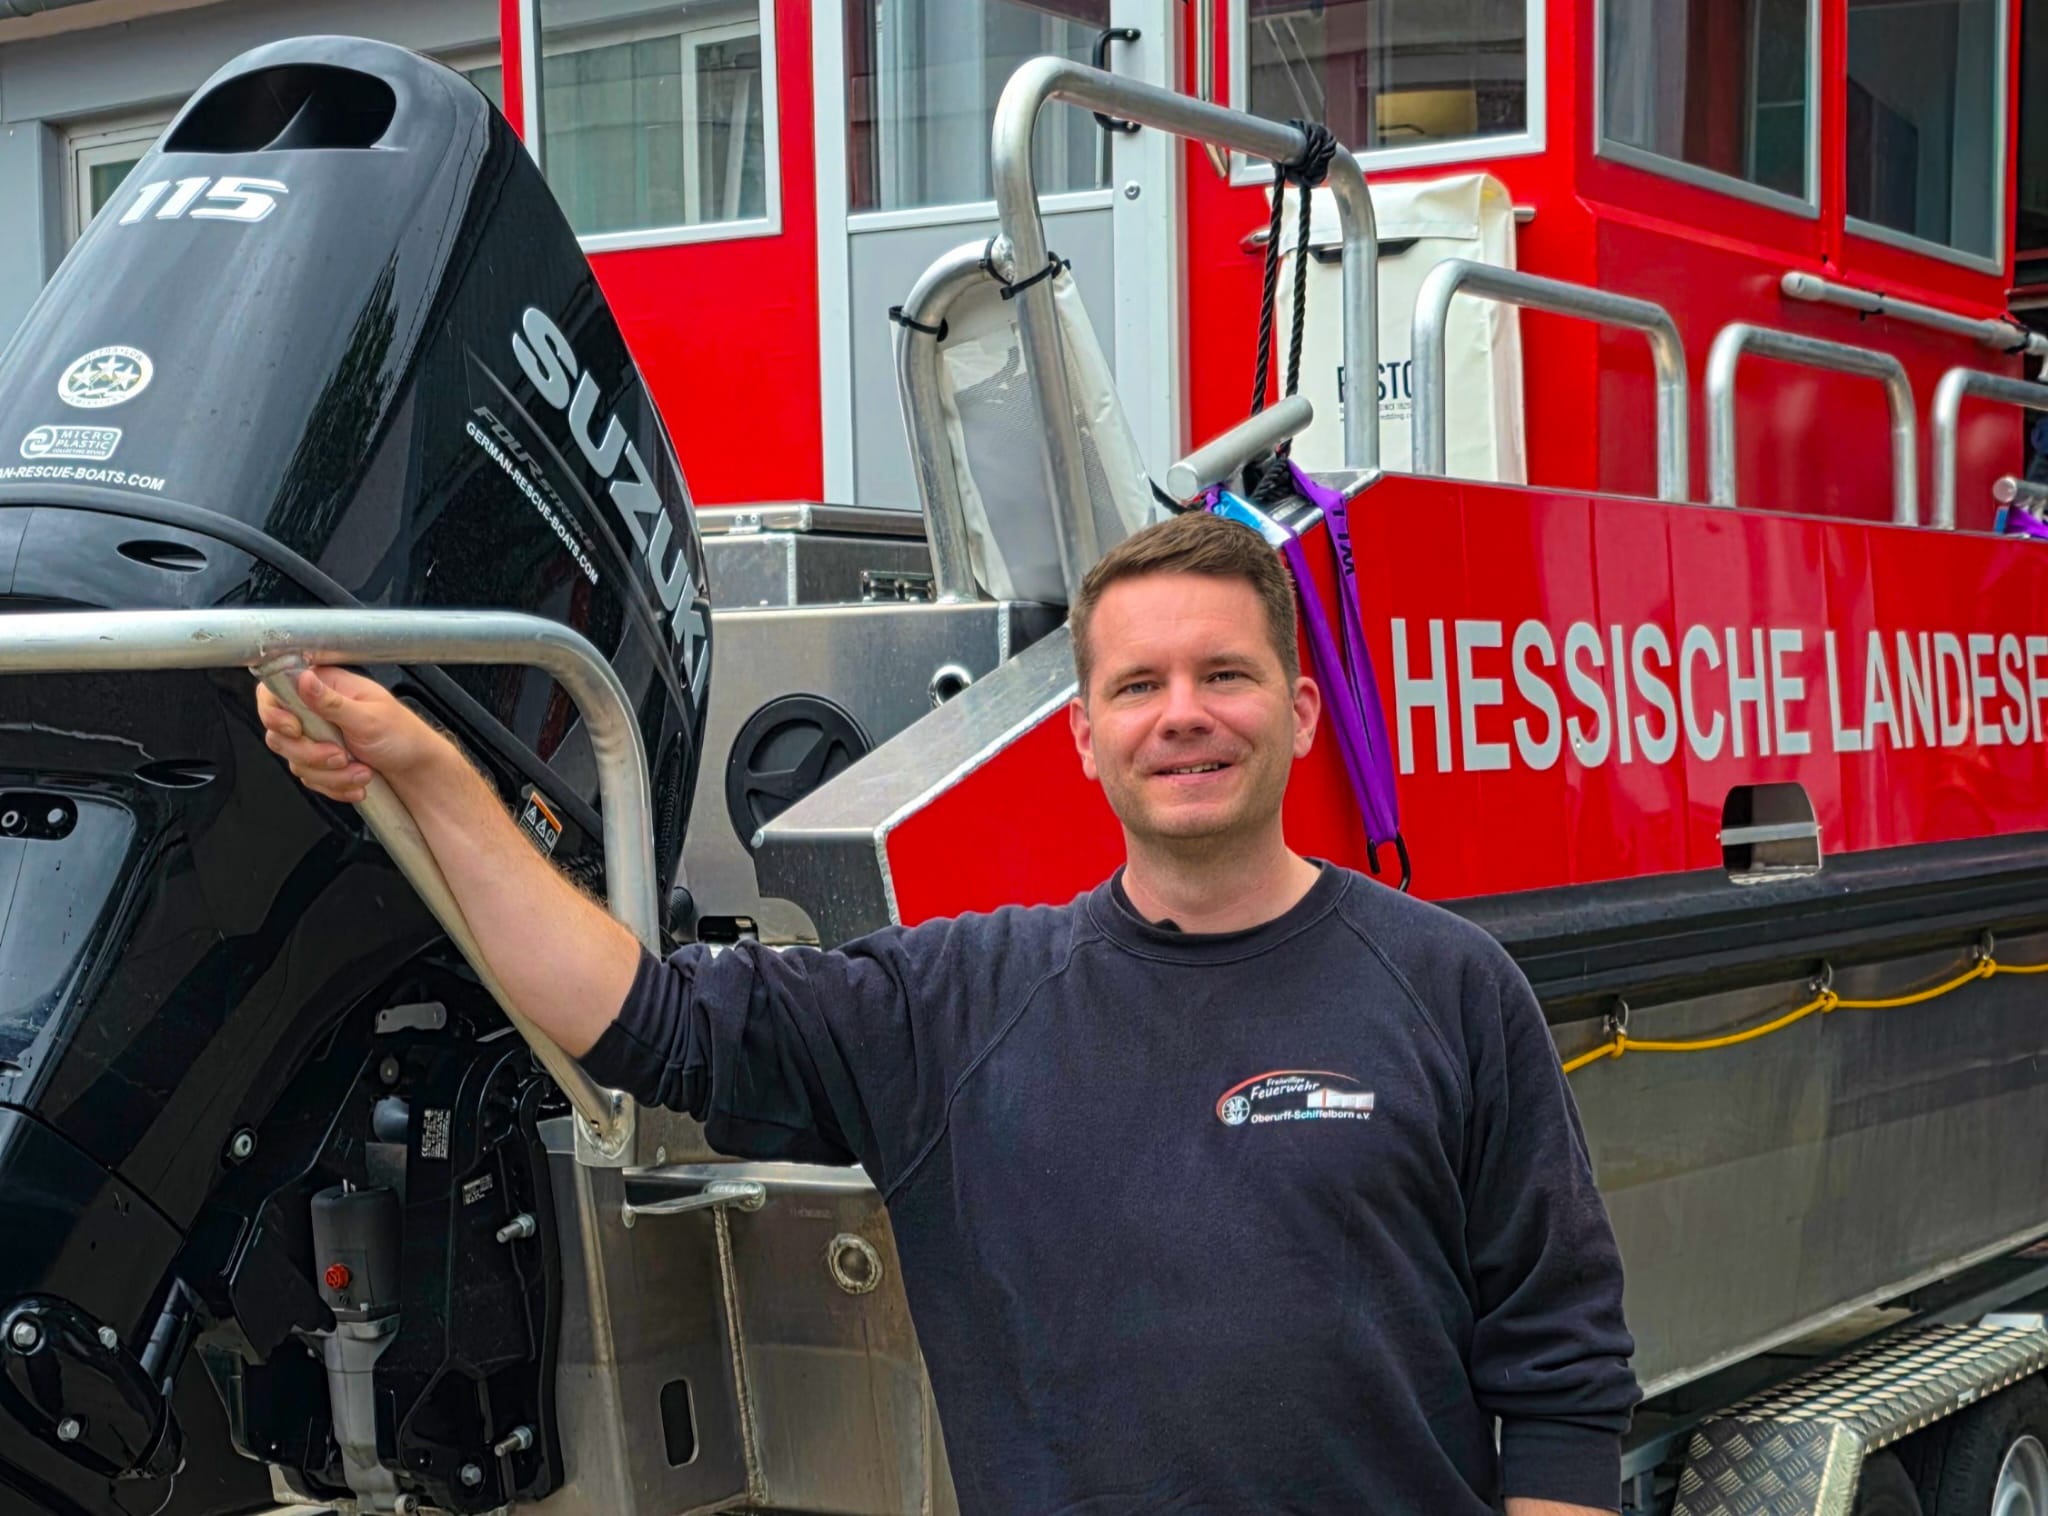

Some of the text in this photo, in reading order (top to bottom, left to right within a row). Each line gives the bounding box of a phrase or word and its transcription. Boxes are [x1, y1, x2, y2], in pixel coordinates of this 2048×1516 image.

[119, 176, 289, 226] 115
[55, 439, 110, 450] PLASTIC
[61, 430, 114, 441] MICRO
[466, 421, 599, 585] GERMAN-RESCUE-BOATS.COM
[512, 307, 709, 709] SUZUKI
[1391, 618, 1810, 774] HESSISCHE
[1251, 1082, 1320, 1100] Feuerwehr
[1251, 1110, 1355, 1124] Oberurff-Schiffelborn
